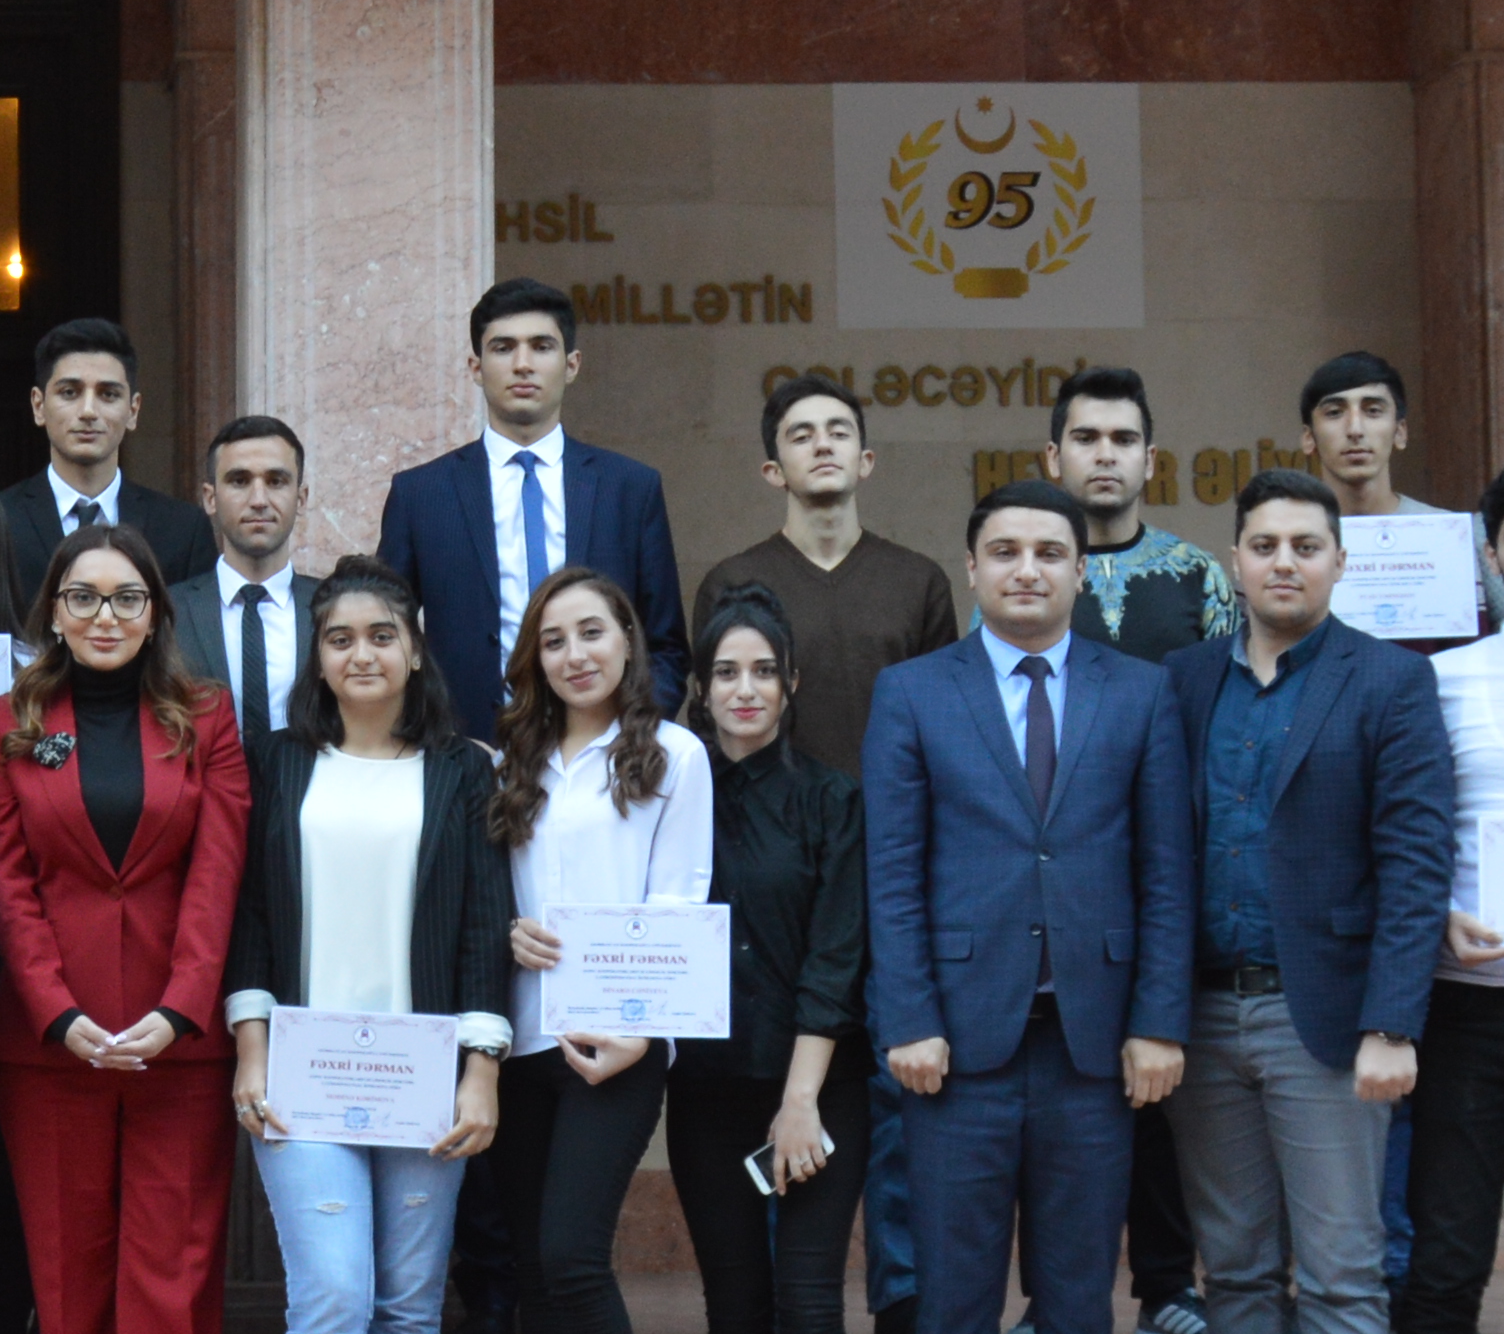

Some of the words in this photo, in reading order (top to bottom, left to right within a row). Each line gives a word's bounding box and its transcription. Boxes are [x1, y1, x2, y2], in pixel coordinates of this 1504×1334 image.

[495, 193, 614, 243] HSİL
[945, 171, 1041, 229] 95
[570, 274, 814, 325] MİLLƏTİN
[583, 952, 624, 964] FƏXRİ
[629, 953, 688, 965] FƏRMAN
[309, 1058, 351, 1072] FƏXRİ
[355, 1063, 415, 1075] FƏRMAN
